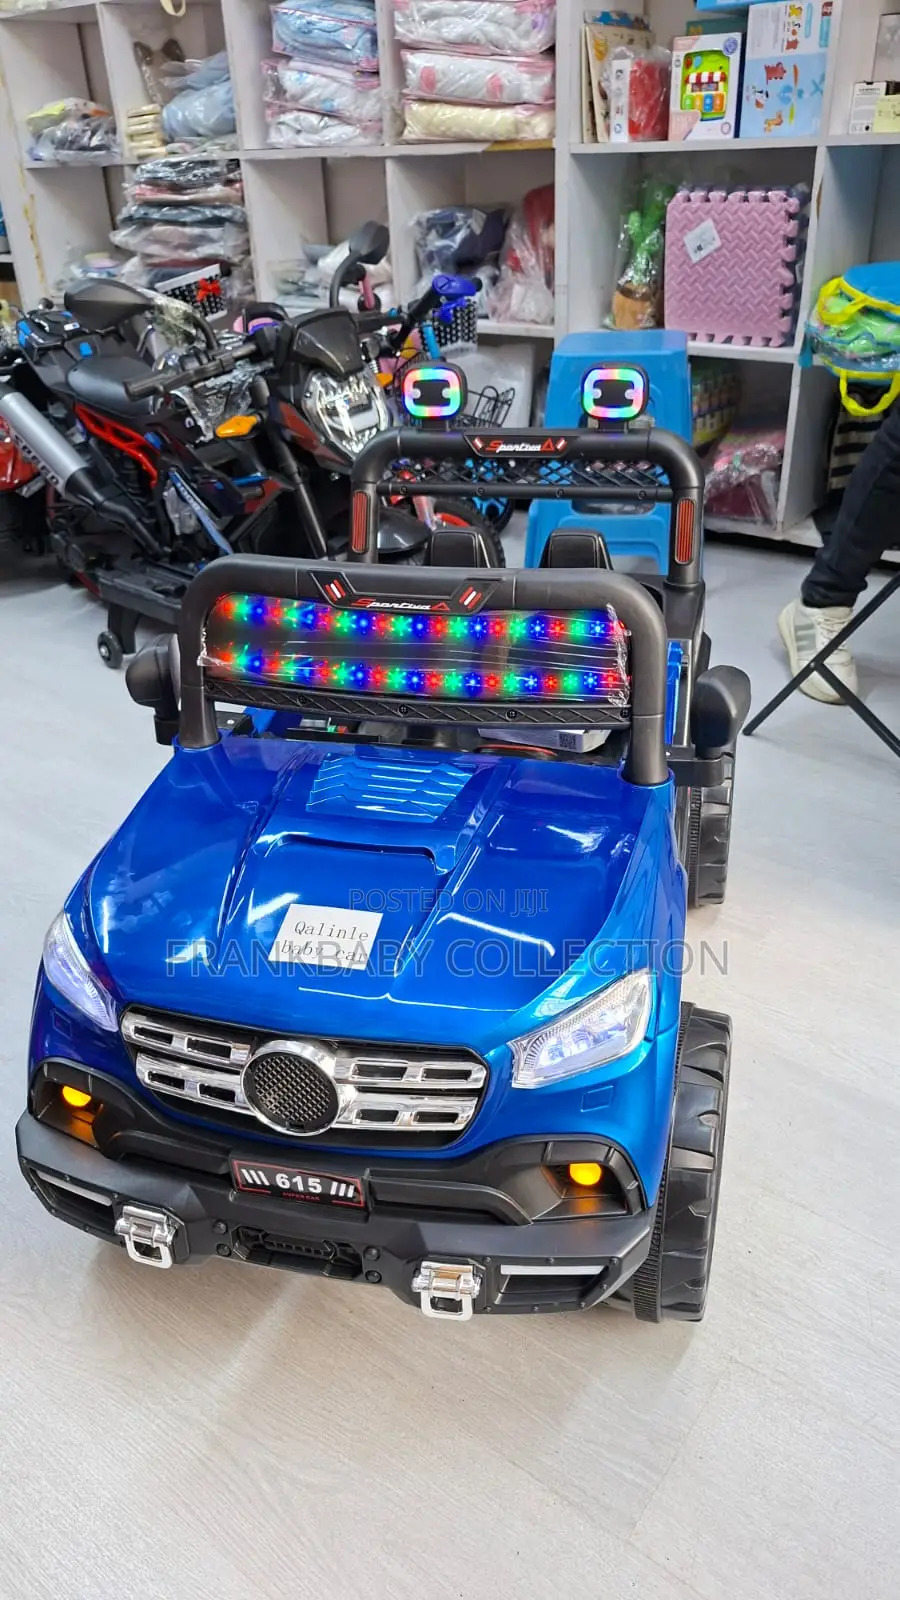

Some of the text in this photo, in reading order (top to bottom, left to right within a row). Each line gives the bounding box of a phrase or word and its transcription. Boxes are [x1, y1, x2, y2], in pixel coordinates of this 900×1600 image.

[294, 920, 369, 942] Qalinle
[281, 940, 369, 963] baby car
[275, 1173, 323, 1194] 615
